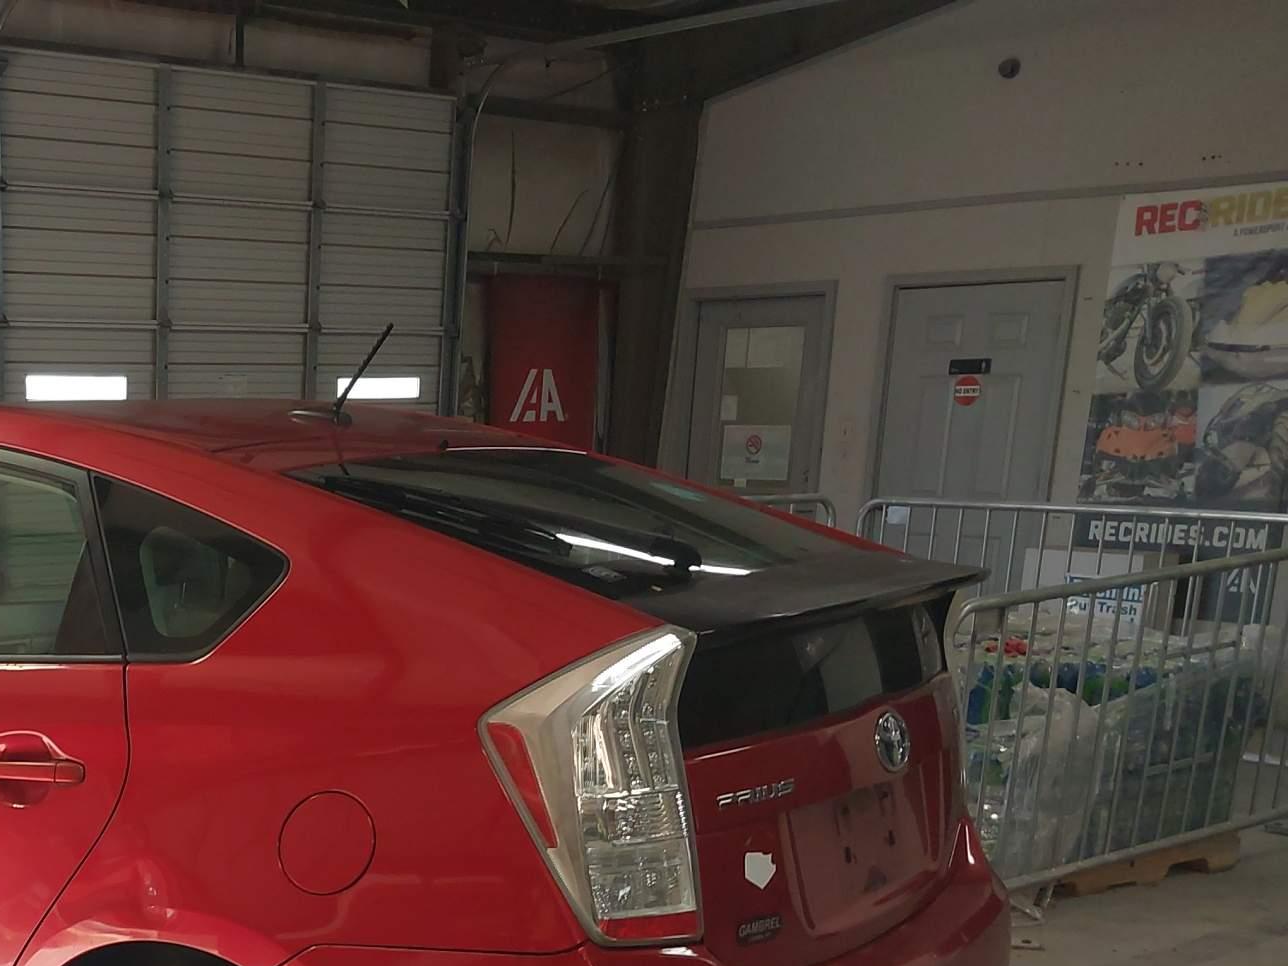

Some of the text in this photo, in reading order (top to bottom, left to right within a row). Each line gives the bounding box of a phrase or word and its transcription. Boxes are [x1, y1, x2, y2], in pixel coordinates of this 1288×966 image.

[1135, 200, 1201, 236] REC
[1088, 520, 1268, 550] RECRIDES.COM
[716, 778, 794, 811] PRIUS
